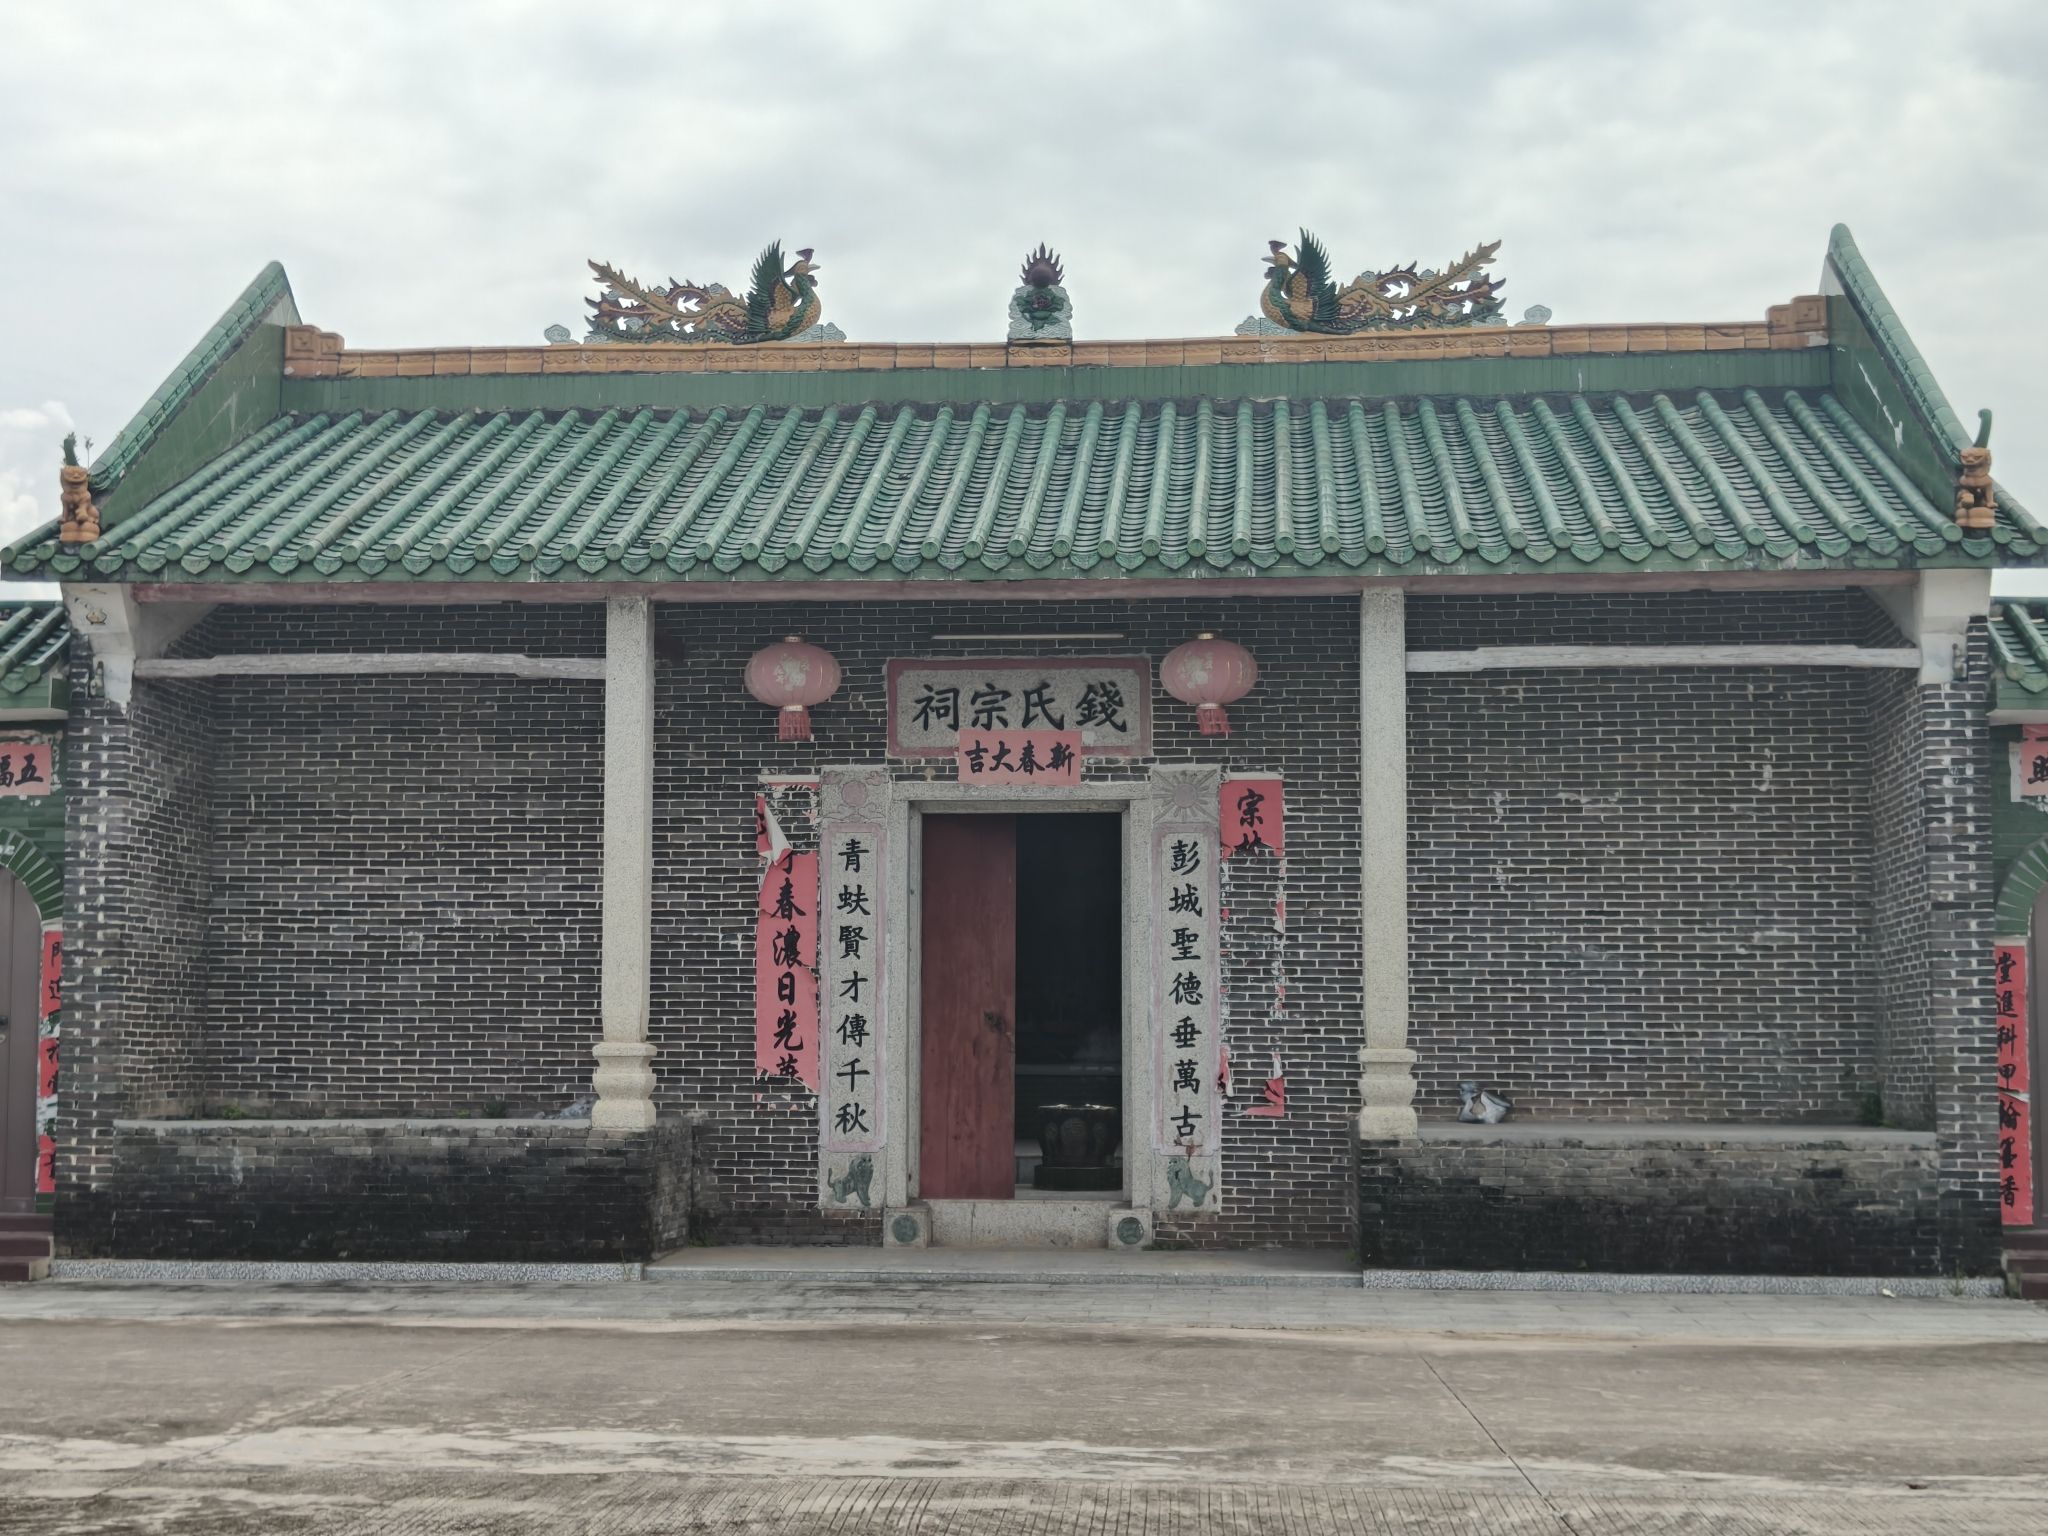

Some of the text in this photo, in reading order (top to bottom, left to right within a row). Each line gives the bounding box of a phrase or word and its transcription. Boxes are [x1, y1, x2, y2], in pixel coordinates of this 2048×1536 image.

[912, 681, 1127, 732] 錢氏宗祠
[964, 740, 1075, 777] 新春大吉
[835, 838, 871, 1135] 青蚨賢才傳千秋
[1168, 840, 1204, 1137] 彭城聖德垂萬古
